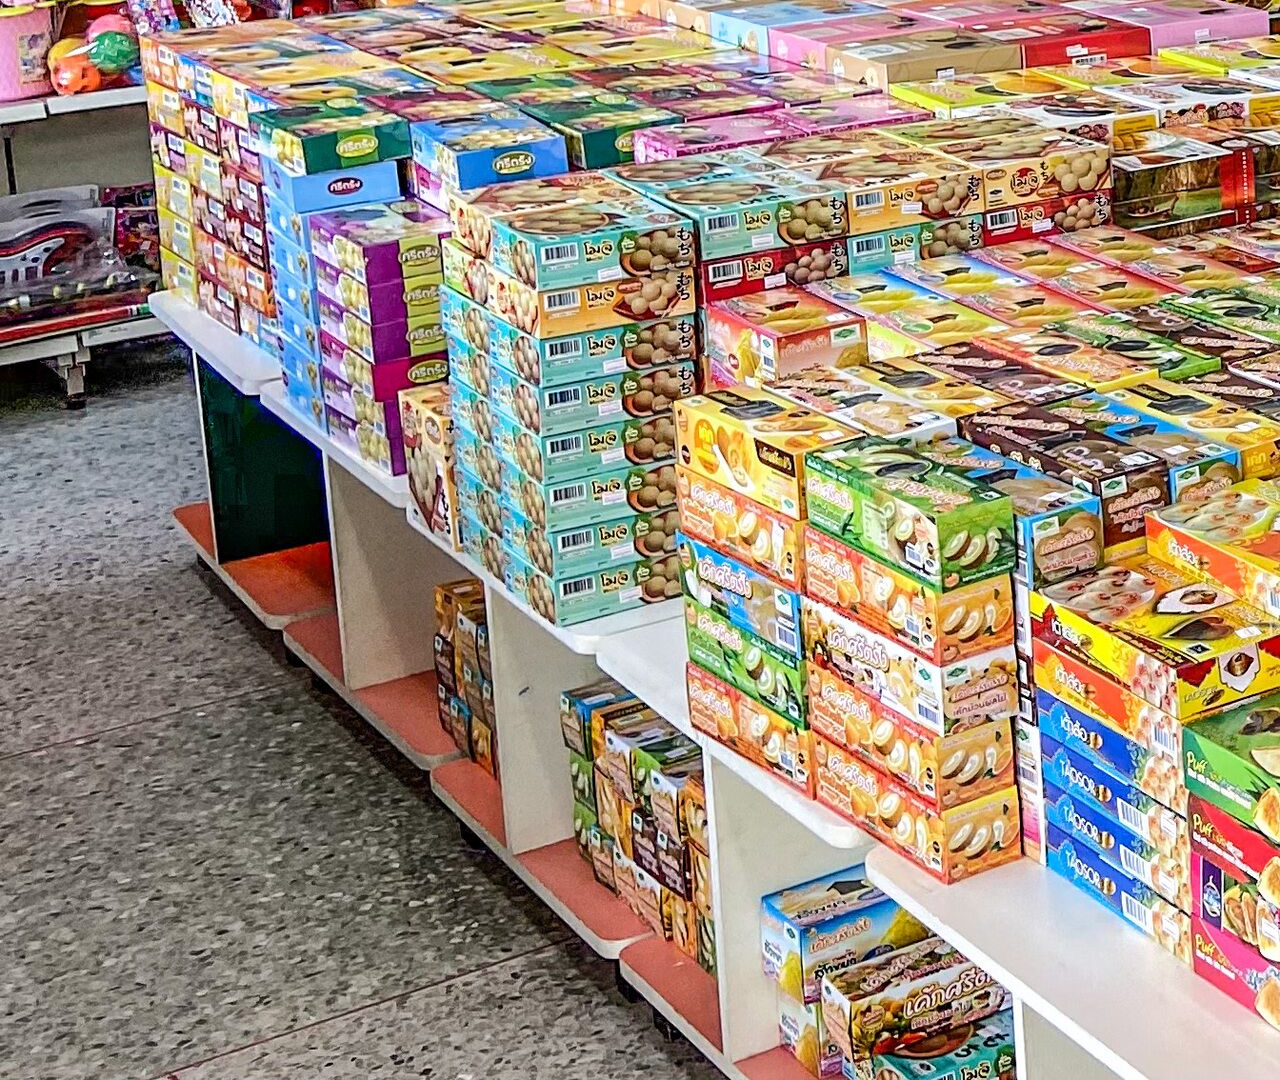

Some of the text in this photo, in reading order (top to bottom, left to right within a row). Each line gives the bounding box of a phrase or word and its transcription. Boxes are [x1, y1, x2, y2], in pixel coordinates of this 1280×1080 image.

[1187, 752, 1207, 774] Puff
[1061, 762, 1096, 798] TAOSOR
[1064, 803, 1099, 839] TAOSOR
[1193, 814, 1214, 837] Puff
[1066, 851, 1101, 886] TAOSOR
[1196, 934, 1215, 956] Puff
